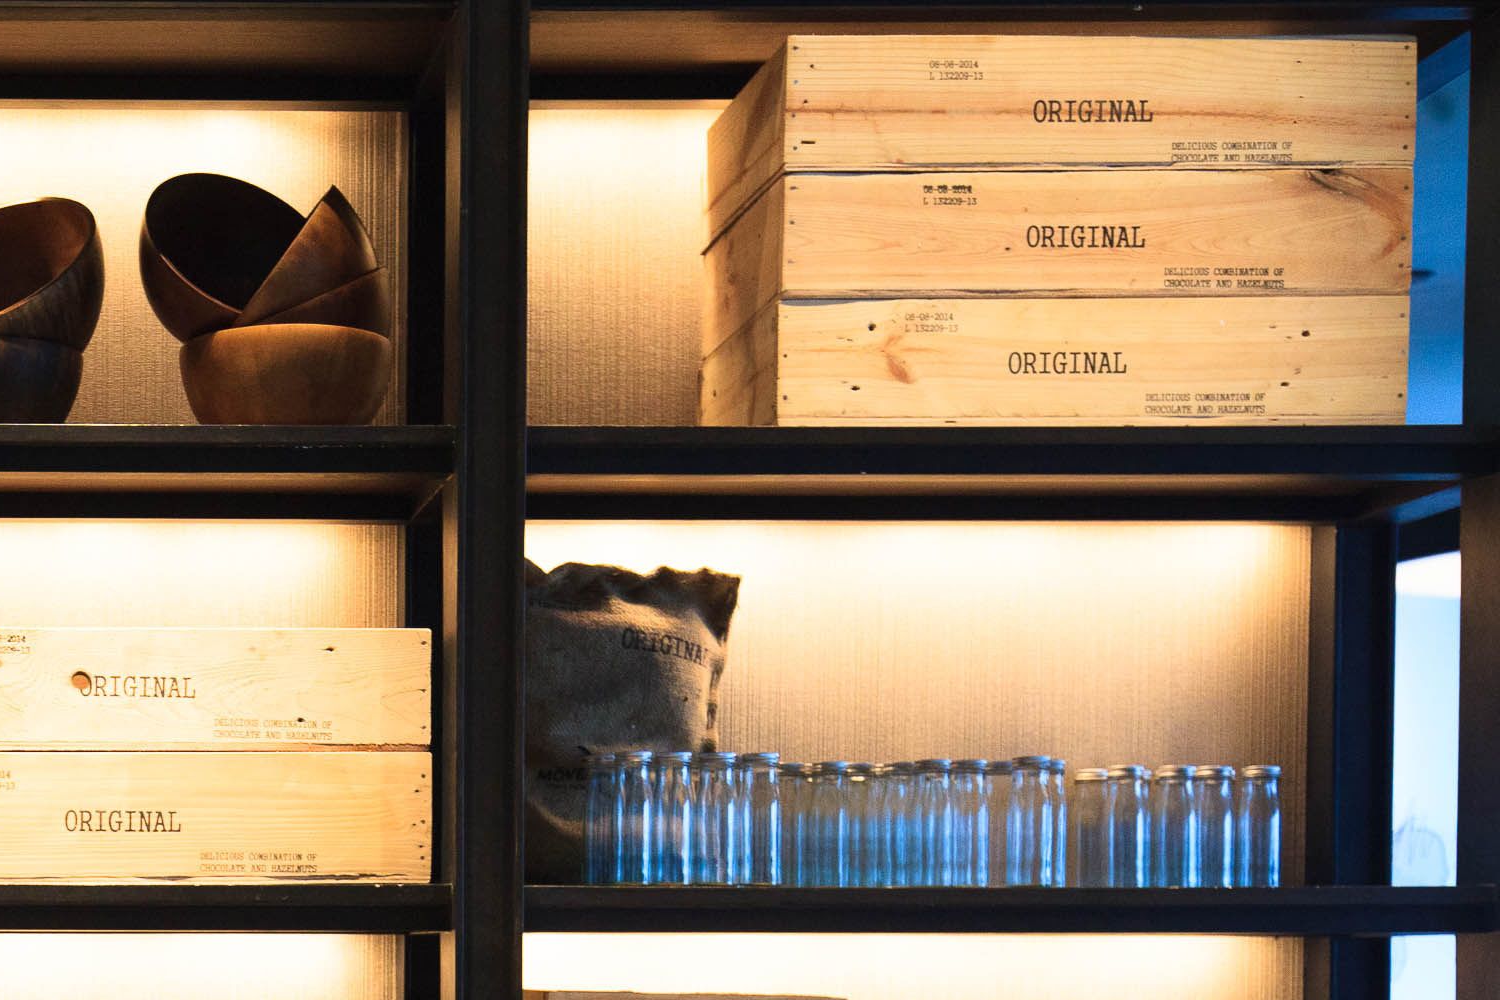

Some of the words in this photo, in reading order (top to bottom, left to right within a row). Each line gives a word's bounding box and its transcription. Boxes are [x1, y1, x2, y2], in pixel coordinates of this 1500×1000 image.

[1033, 99, 1154, 123] ORIGINAL
[1171, 142, 1217, 150] DELICIOUS
[1221, 142, 1277, 150] COMBINATION
[1282, 142, 1293, 150] OF
[1171, 153, 1219, 161] CHOCOLATE
[1224, 153, 1240, 161] AND
[1244, 153, 1293, 161] HAZELNUTS
[1026, 225, 1146, 248] ORIGINAL
[1164, 267, 1209, 276] DELICIOUS
[1213, 267, 1269, 276] COMBINATION
[1273, 267, 1284, 276] OF
[1164, 279, 1211, 288] CHOCOLATE
[1216, 279, 1232, 288] AND
[1237, 279, 1284, 288] HAZELNUTS
[1008, 351, 1127, 374] ORIGINAL
[1145, 393, 1190, 401] DELICIOUS
[1195, 393, 1250, 401] COMBINATION
[1255, 393, 1266, 401] OF
[1145, 405, 1192, 414] CHOCOLATE
[1197, 405, 1213, 414] AND
[1218, 405, 1266, 414] HAZELNUTS
[622, 628, 709, 667] ORIGINA
[65, 810, 181, 832] ORIGINAL
